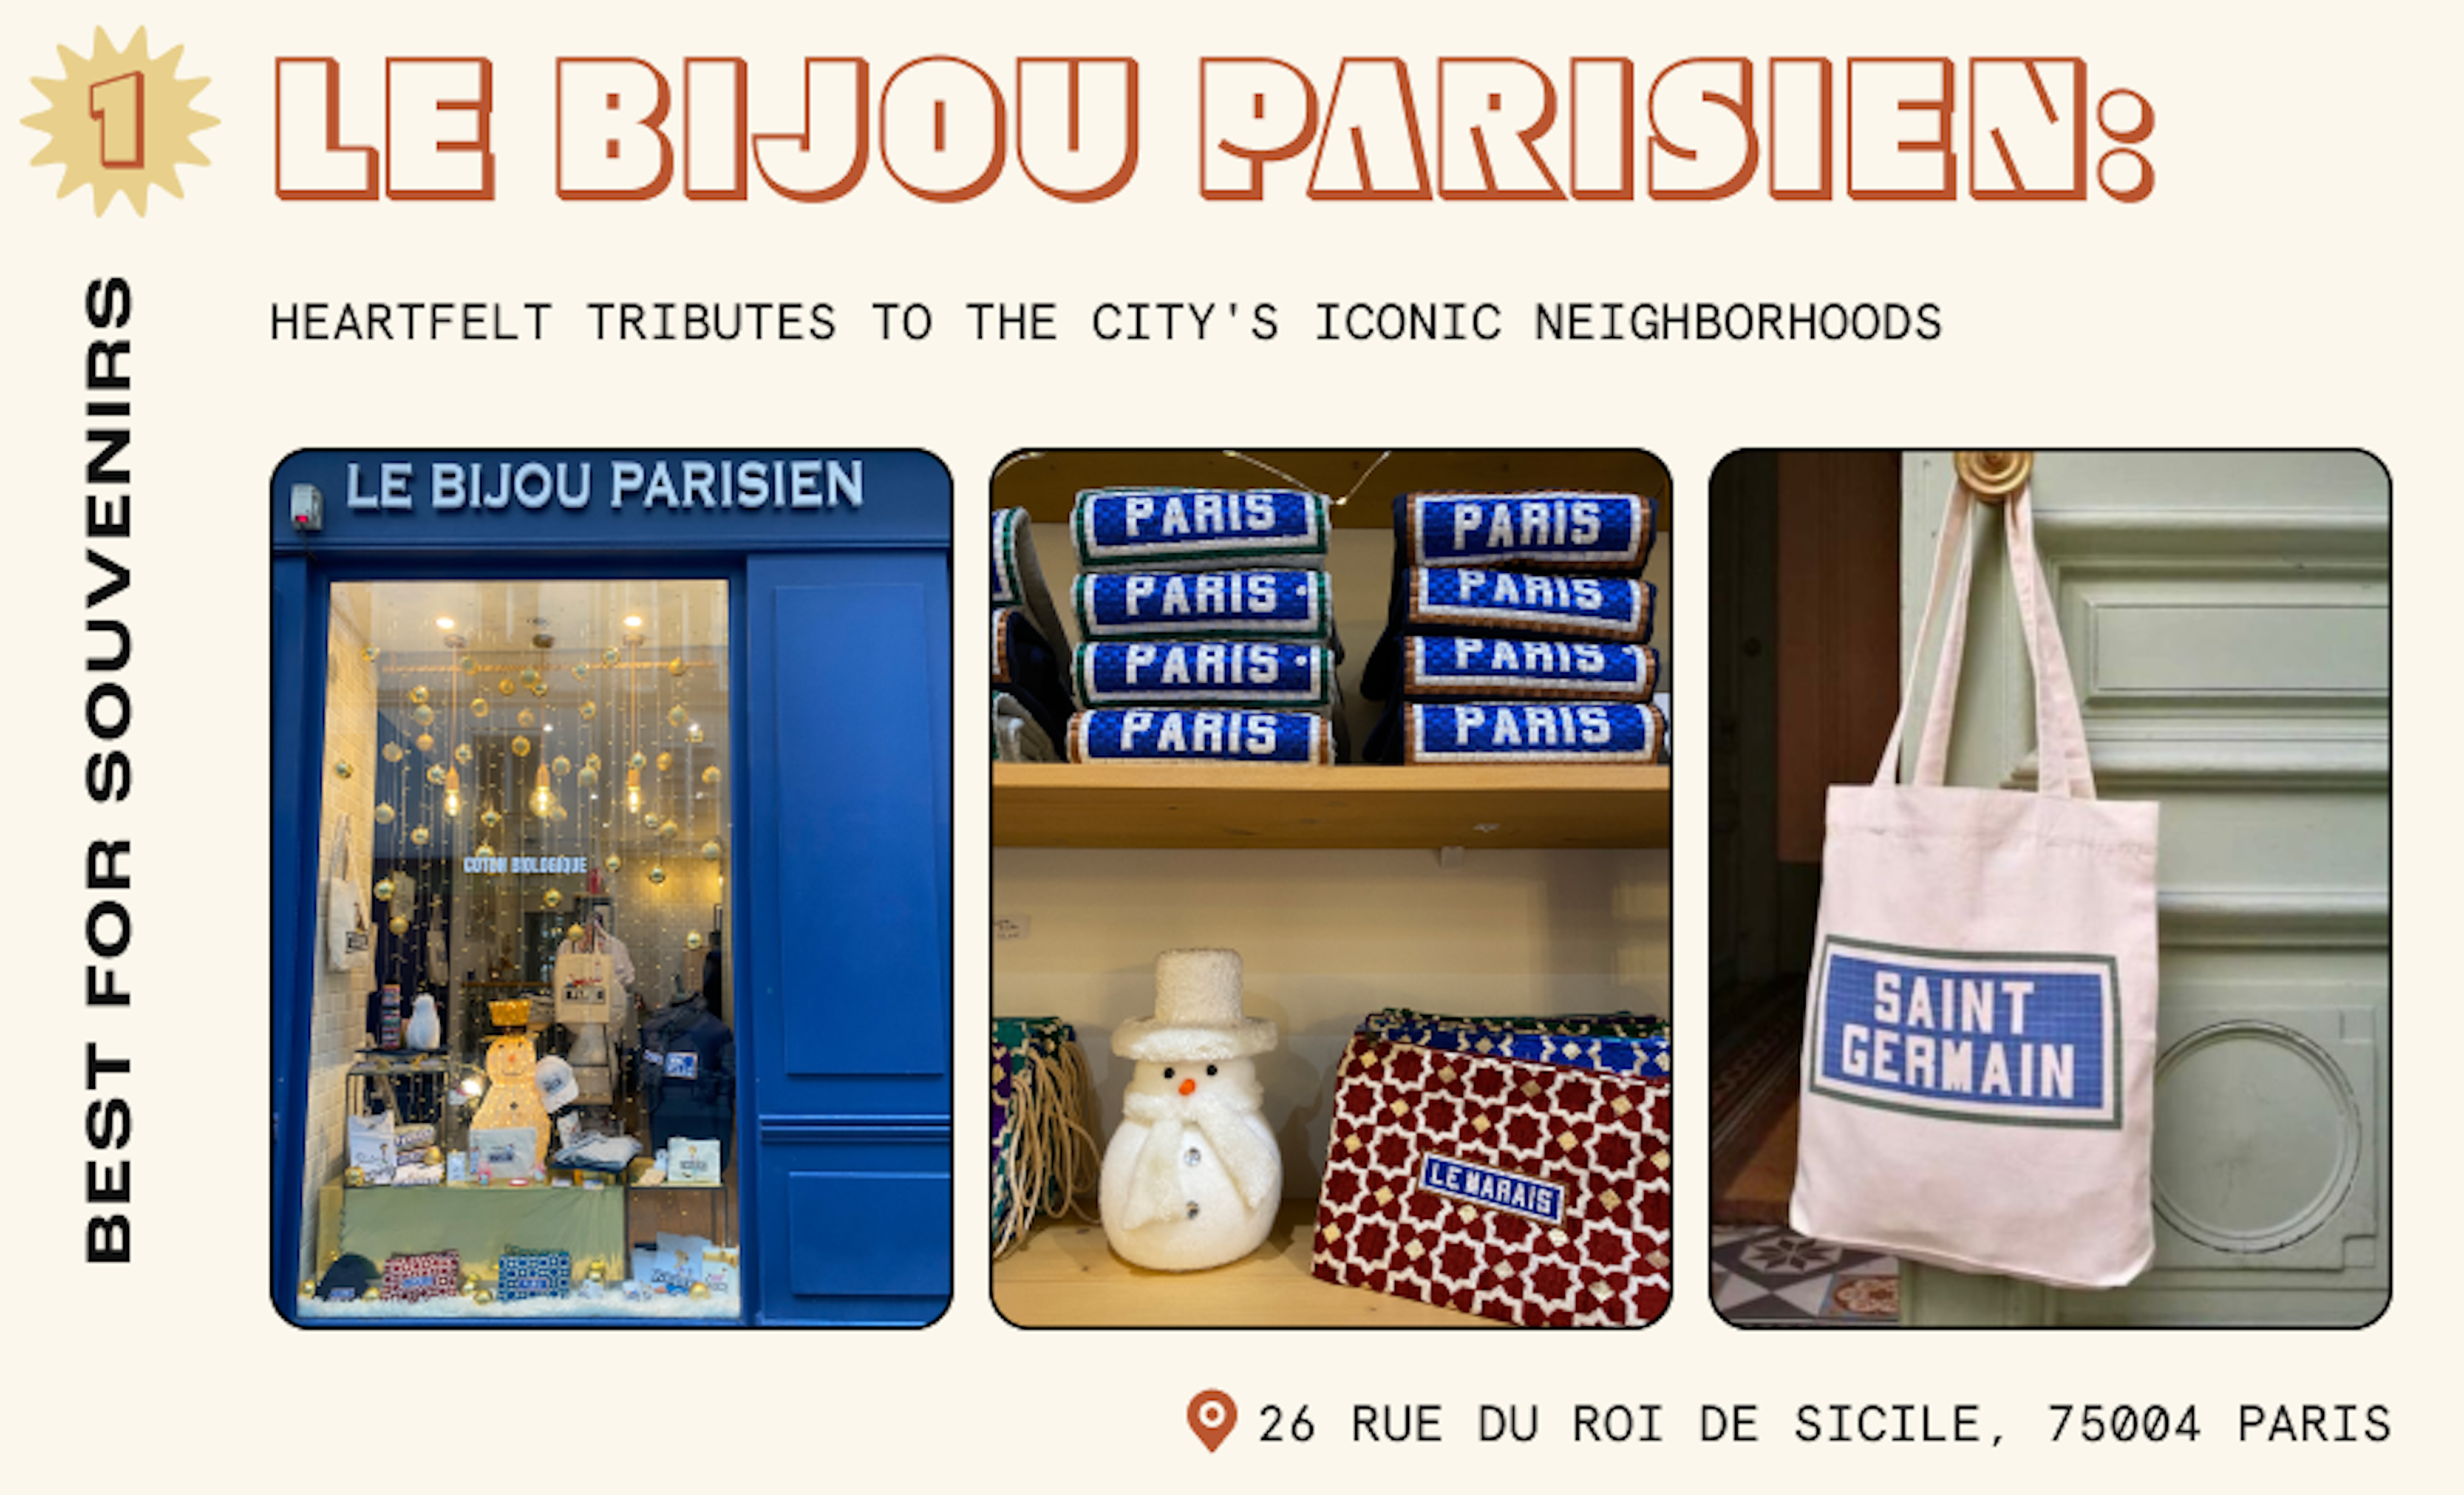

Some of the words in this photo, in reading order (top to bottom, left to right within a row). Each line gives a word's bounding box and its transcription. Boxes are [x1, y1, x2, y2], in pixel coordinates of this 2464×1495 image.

[346, 462, 413, 509] LE
[432, 462, 592, 509] BIJOU
[610, 459, 864, 509] PARISIEN
[1125, 493, 1276, 537] PARIS
[1453, 499, 1602, 551] PARIS
[1125, 573, 1277, 616] PARIS
[1456, 567, 1604, 610] PARIS
[1125, 644, 1279, 685] PARIS
[1455, 638, 1605, 673] PARIS
[1120, 711, 1278, 755] PARIS
[1454, 705, 1612, 746] PARIS
[1874, 970, 2035, 1035] SAINT
[1842, 1023, 2075, 1100] GERMAIN
[1430, 1163, 1464, 1191] LE
[1465, 1170, 1553, 1215] MARAIS
